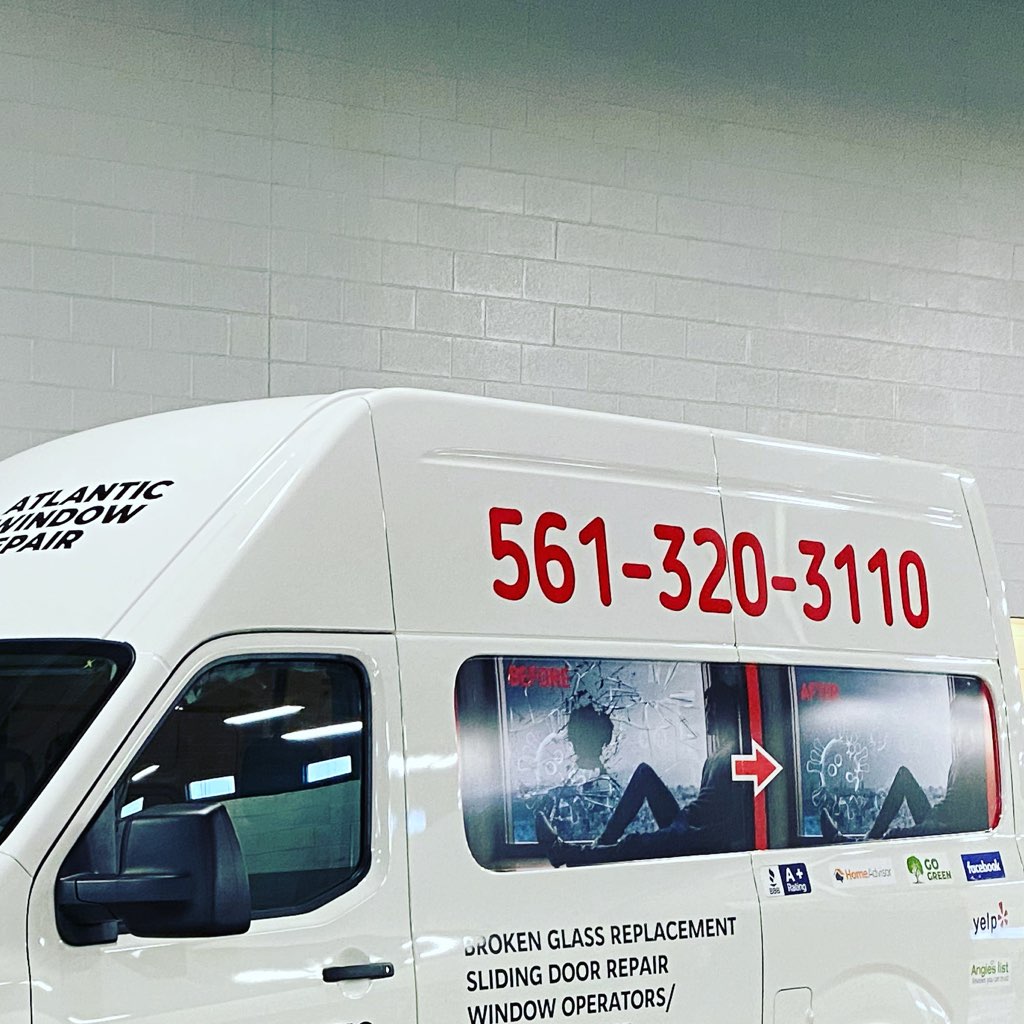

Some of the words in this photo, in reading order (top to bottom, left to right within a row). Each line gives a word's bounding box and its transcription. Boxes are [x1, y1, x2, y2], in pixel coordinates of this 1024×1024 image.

[3, 479, 175, 515] ATLANTIC
[489, 507, 931, 629] 561-320-3110
[786, 867, 803, 882] A+
[924, 859, 939, 870] GO
[927, 871, 952, 881] GREEN
[967, 858, 1001, 873] facebook
[464, 930, 542, 956] BROKEN
[547, 926, 605, 950] GLASS
[611, 916, 737, 945] REPLACEMENT
[973, 912, 997, 935] yelp
[466, 965, 543, 992] SLIDING
[548, 959, 601, 984] DOOR
[606, 954, 669, 979] REPAIR
[561, 983, 676, 1018] OPERATORS/
